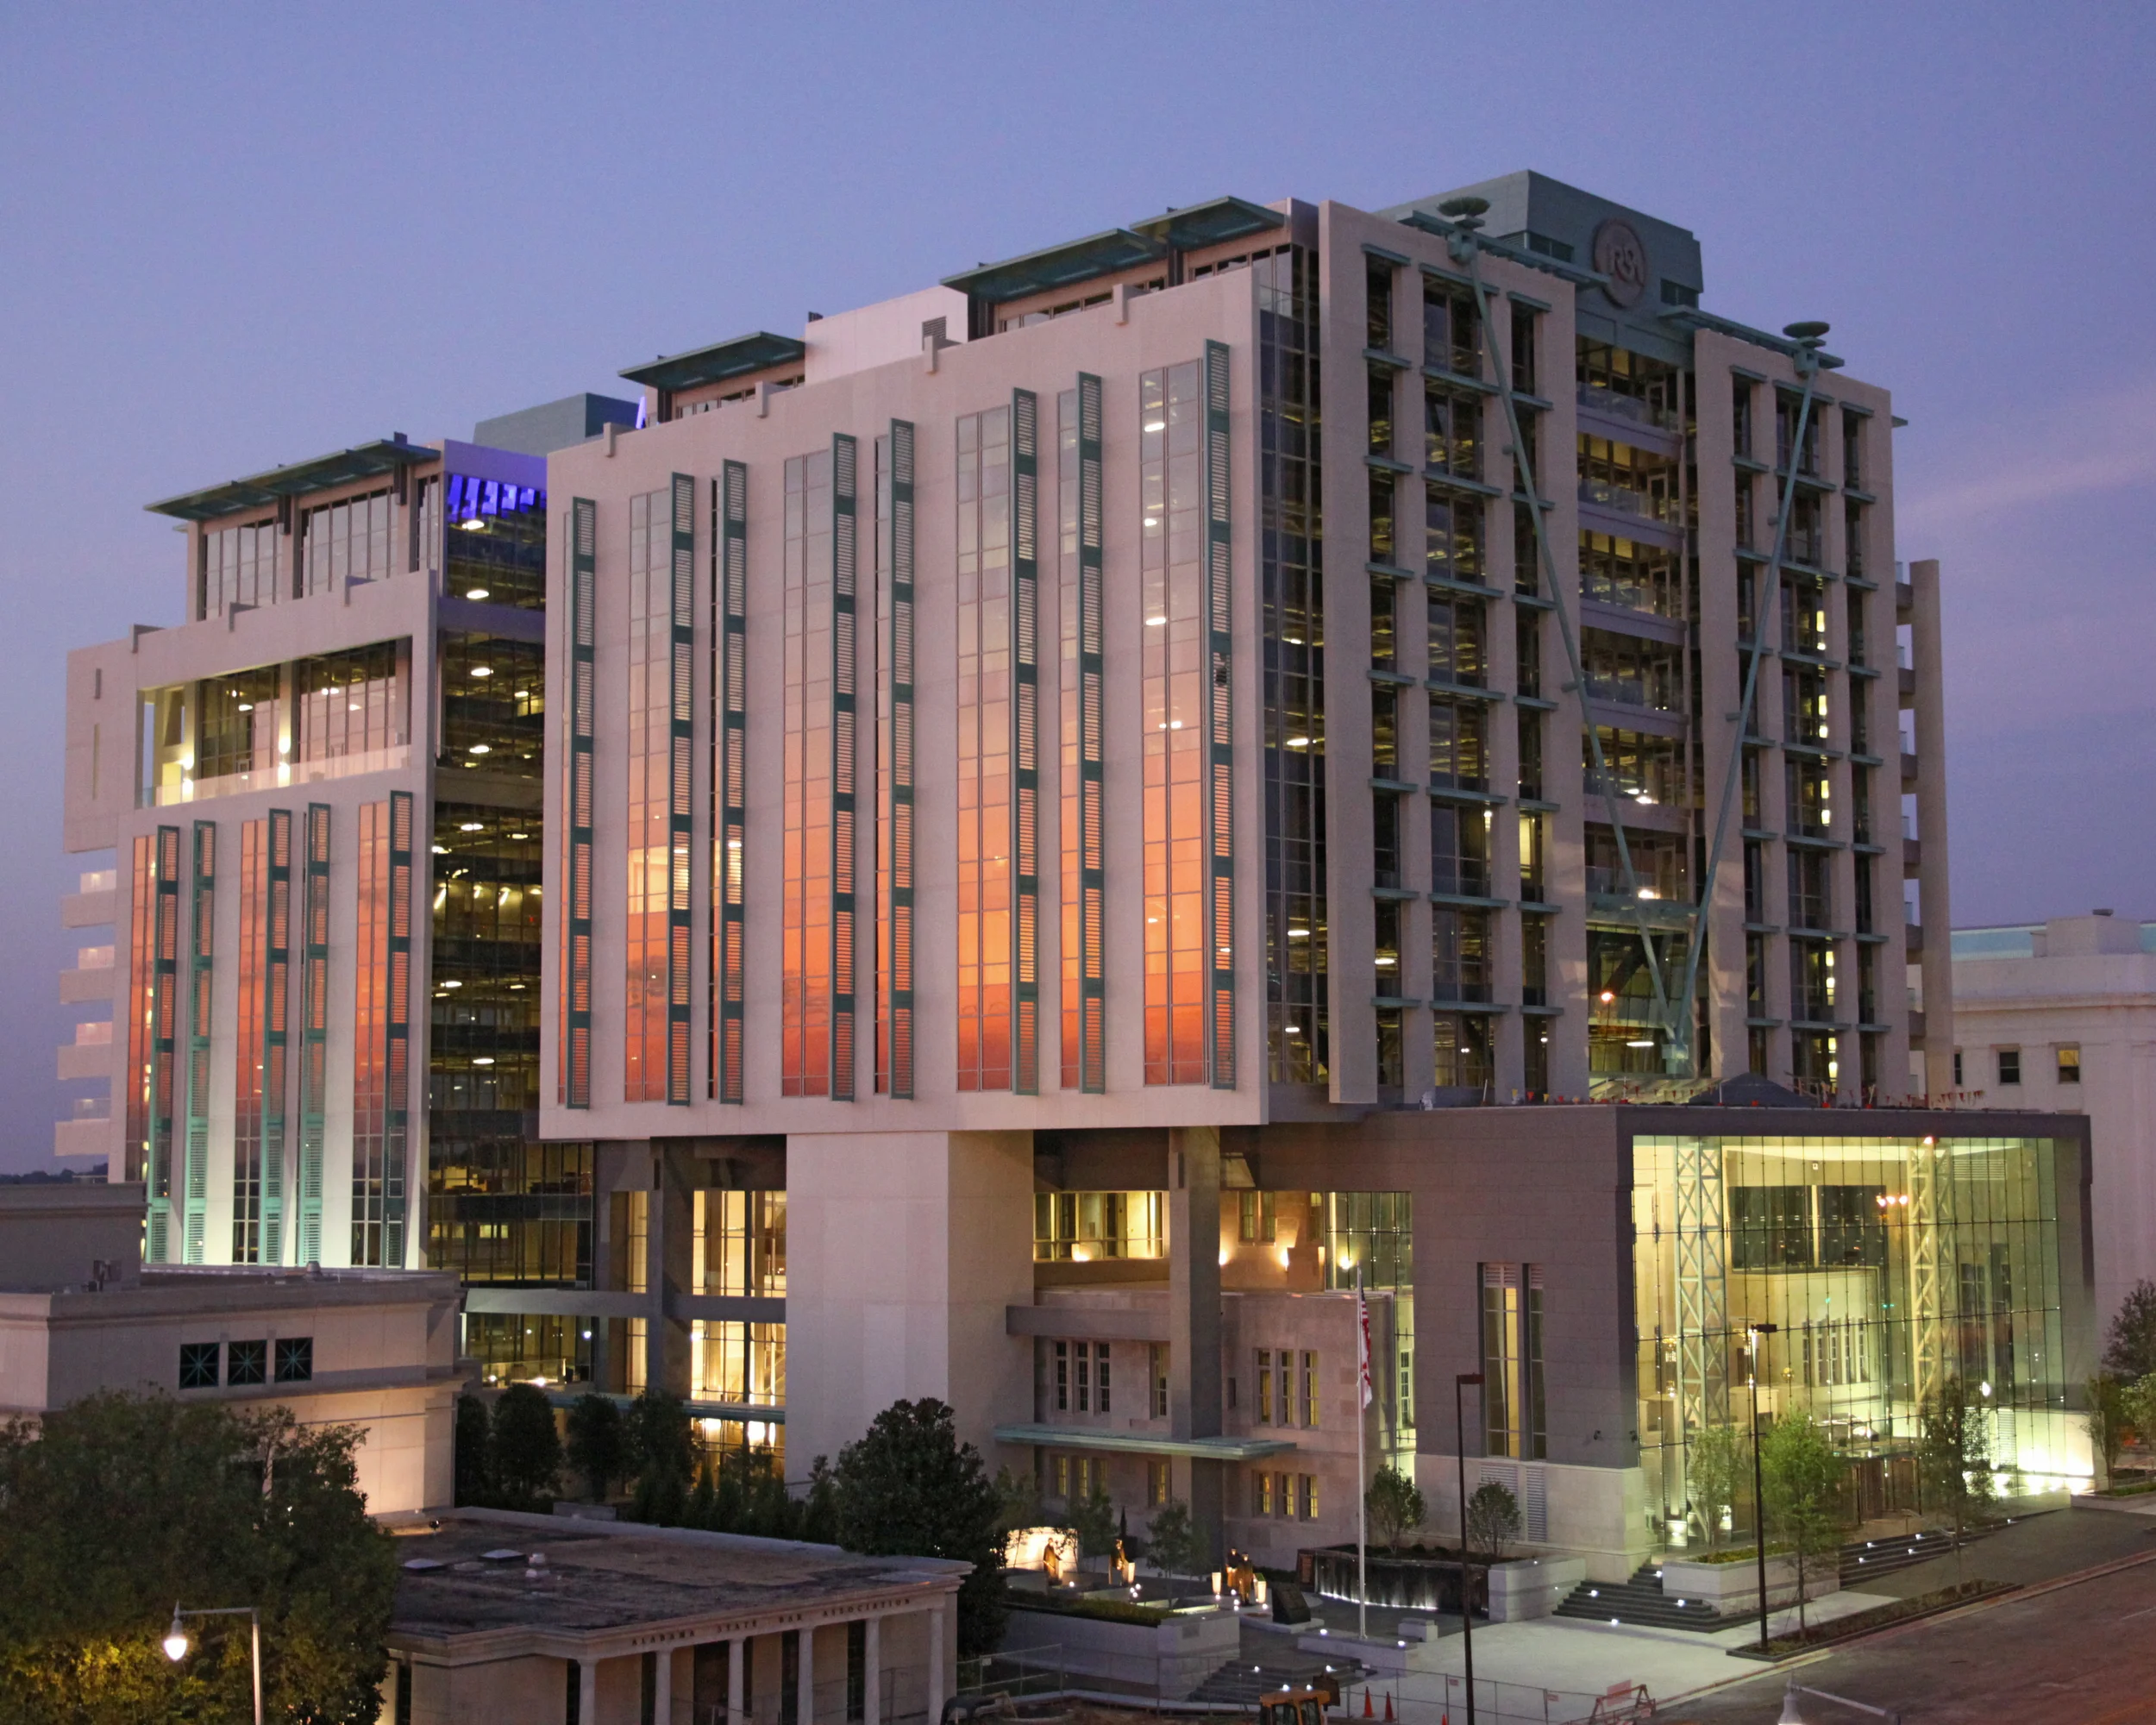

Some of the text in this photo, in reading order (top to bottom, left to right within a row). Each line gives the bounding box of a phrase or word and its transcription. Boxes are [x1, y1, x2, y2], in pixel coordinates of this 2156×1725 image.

[632, 1598, 911, 1646] ALABAMA STATE BAR ASSOCIATION
